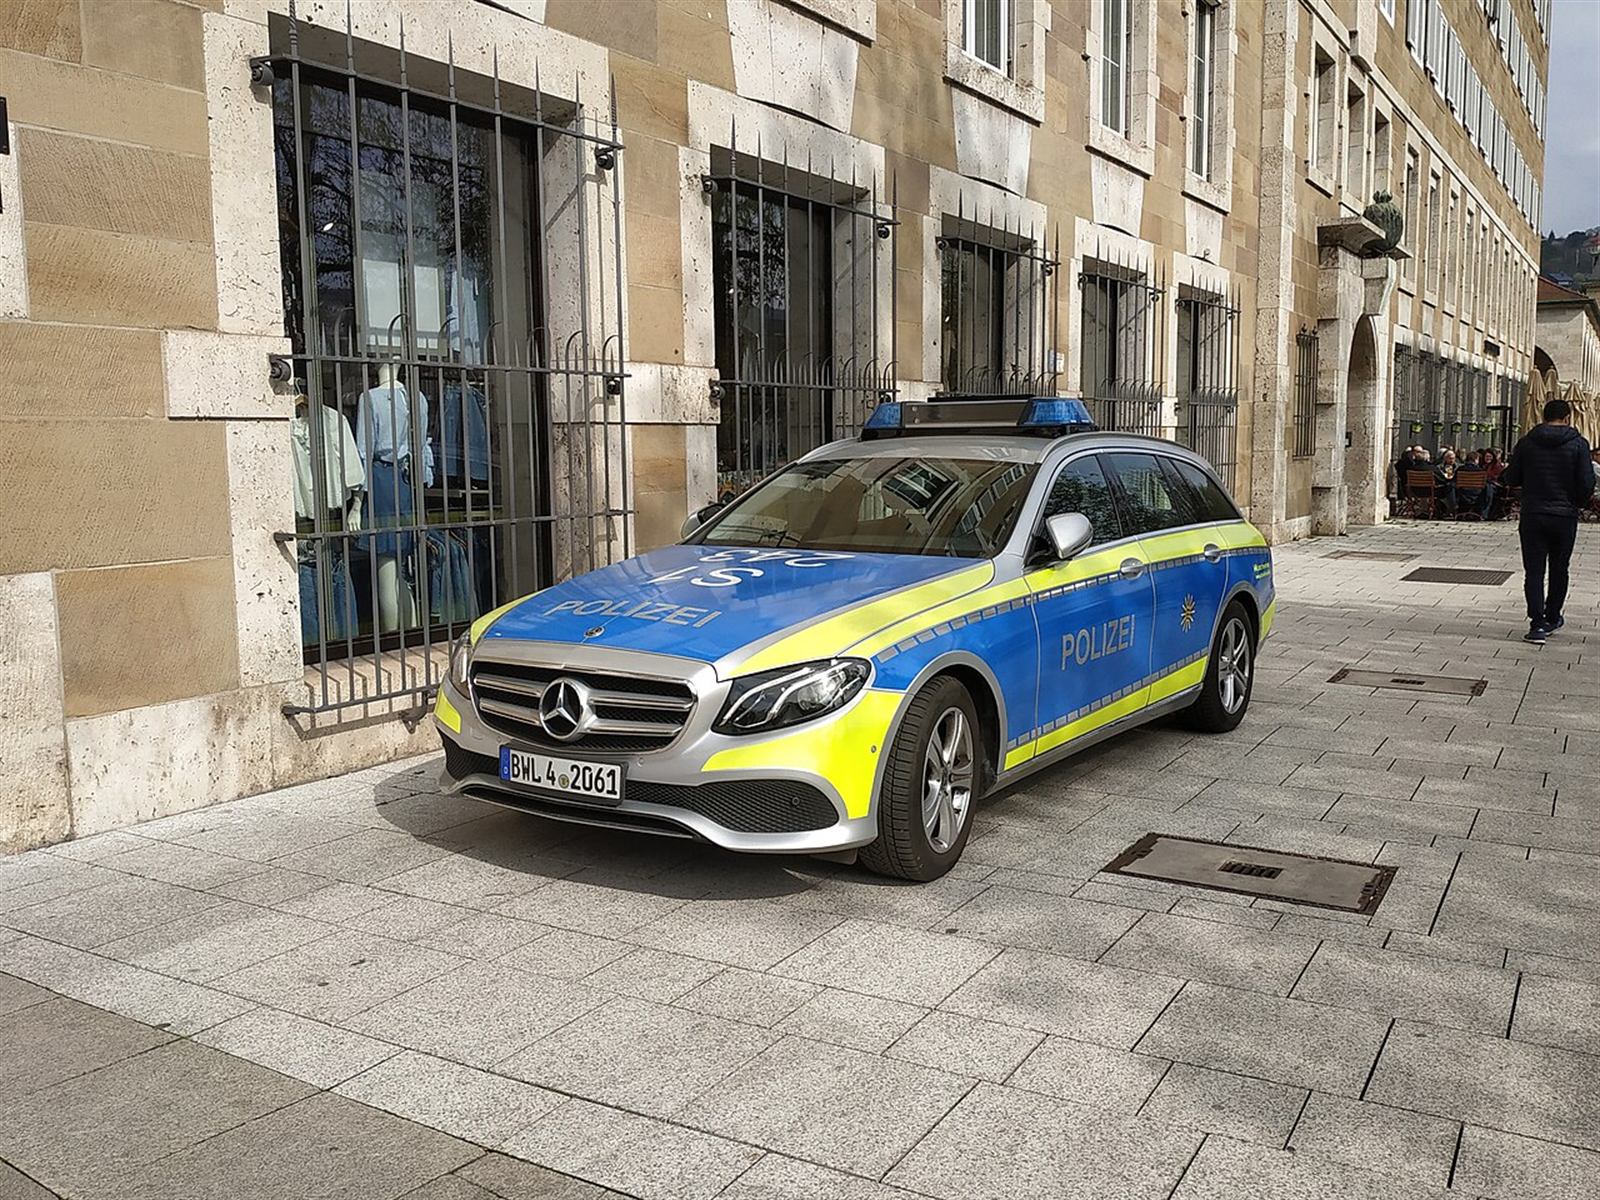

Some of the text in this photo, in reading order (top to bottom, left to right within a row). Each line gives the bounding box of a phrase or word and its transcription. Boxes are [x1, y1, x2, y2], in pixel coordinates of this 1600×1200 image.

[699, 549, 856, 566] 243
[543, 599, 721, 628] POLIZEI
[1061, 614, 1135, 671] POLIZEI
[511, 753, 618, 796] BWL 4 2061
